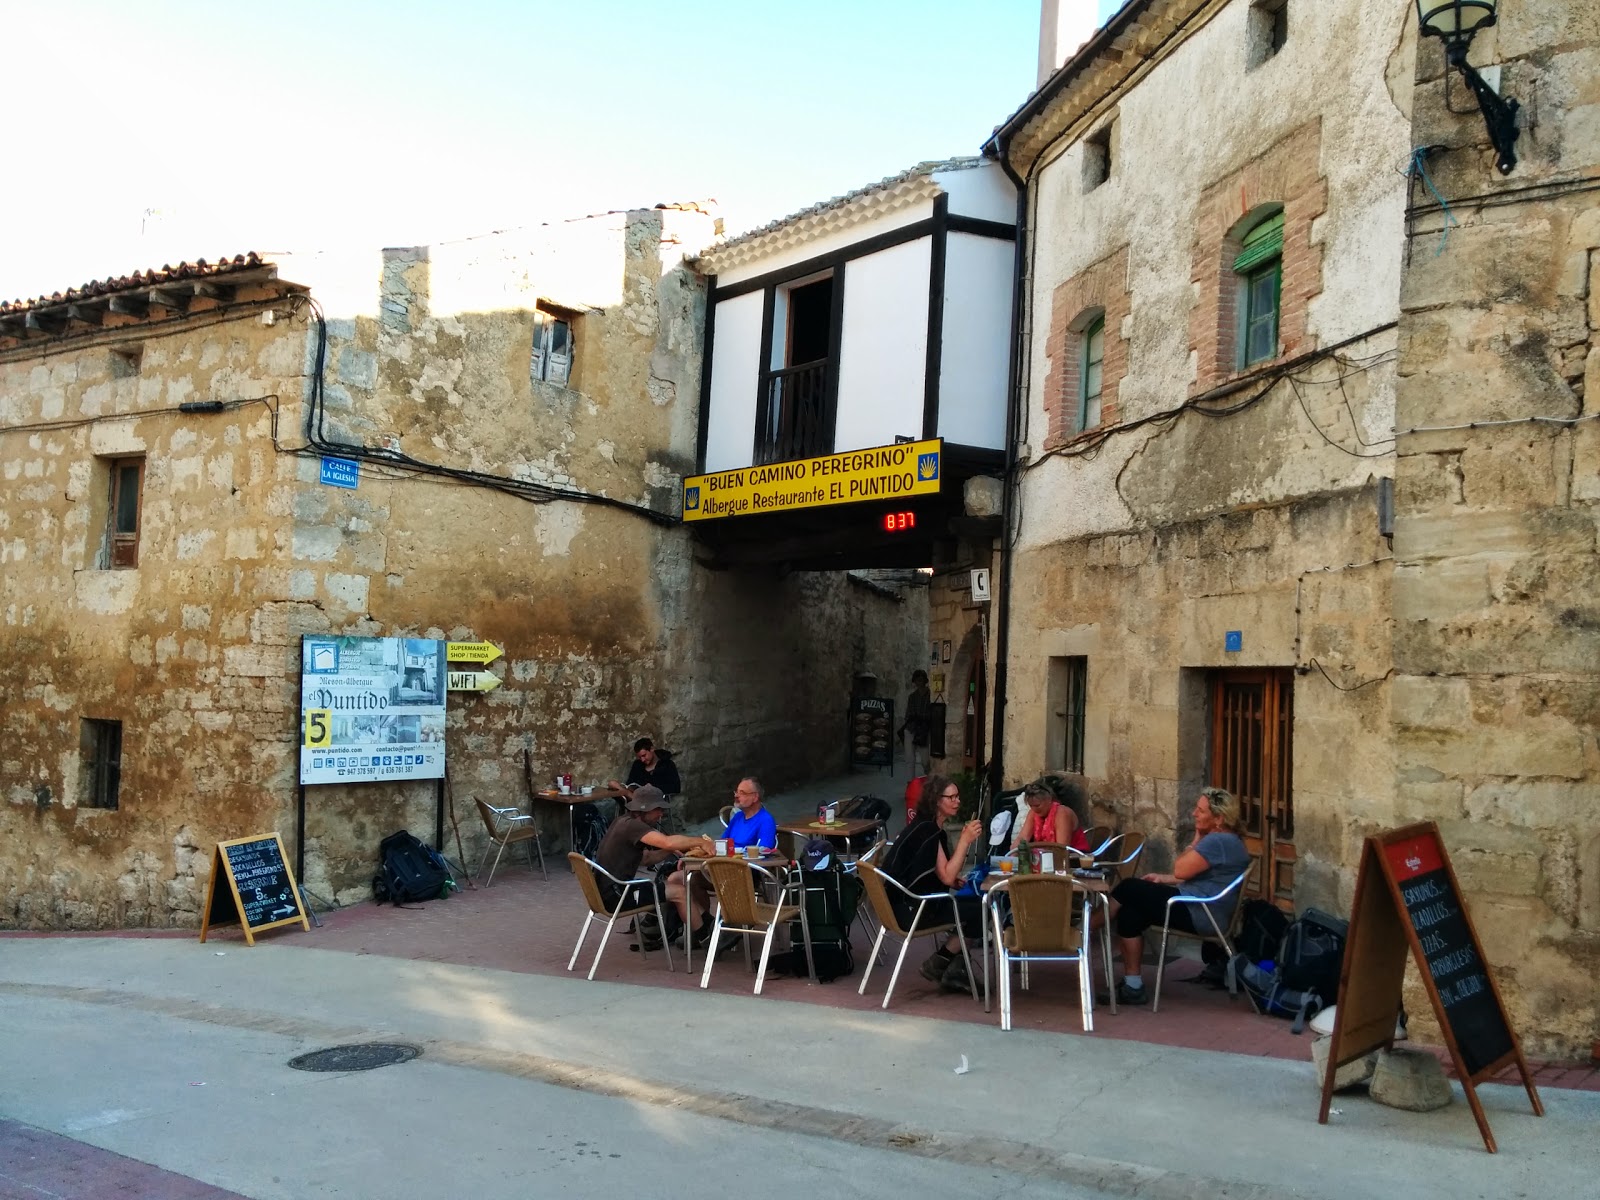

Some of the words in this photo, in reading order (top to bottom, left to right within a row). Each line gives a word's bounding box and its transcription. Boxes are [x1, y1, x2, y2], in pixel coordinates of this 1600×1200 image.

[323, 470, 331, 479] LA
[333, 472, 355, 482] IGLESIA
[703, 472, 744, 491] "BUEN
[749, 463, 806, 485] CAMINO
[812, 446, 914, 477] PEREGRINO"
[702, 494, 748, 516] Albergue
[752, 488, 825, 509] Restaurante
[829, 482, 845, 500] EL
[850, 473, 914, 498] PUNTIDO
[451, 674, 476, 689] WIFI
[309, 690, 316, 701] el
[317, 688, 388, 710] Puntido
[860, 699, 886, 712] PIZZAS
[310, 713, 326, 743] 5
[312, 747, 362, 755] www.puntido.com
[347, 767, 356, 775] 947
[231, 859, 266, 873] BOCADILLOS
[1430, 944, 1477, 977] AMBURGUESAS
